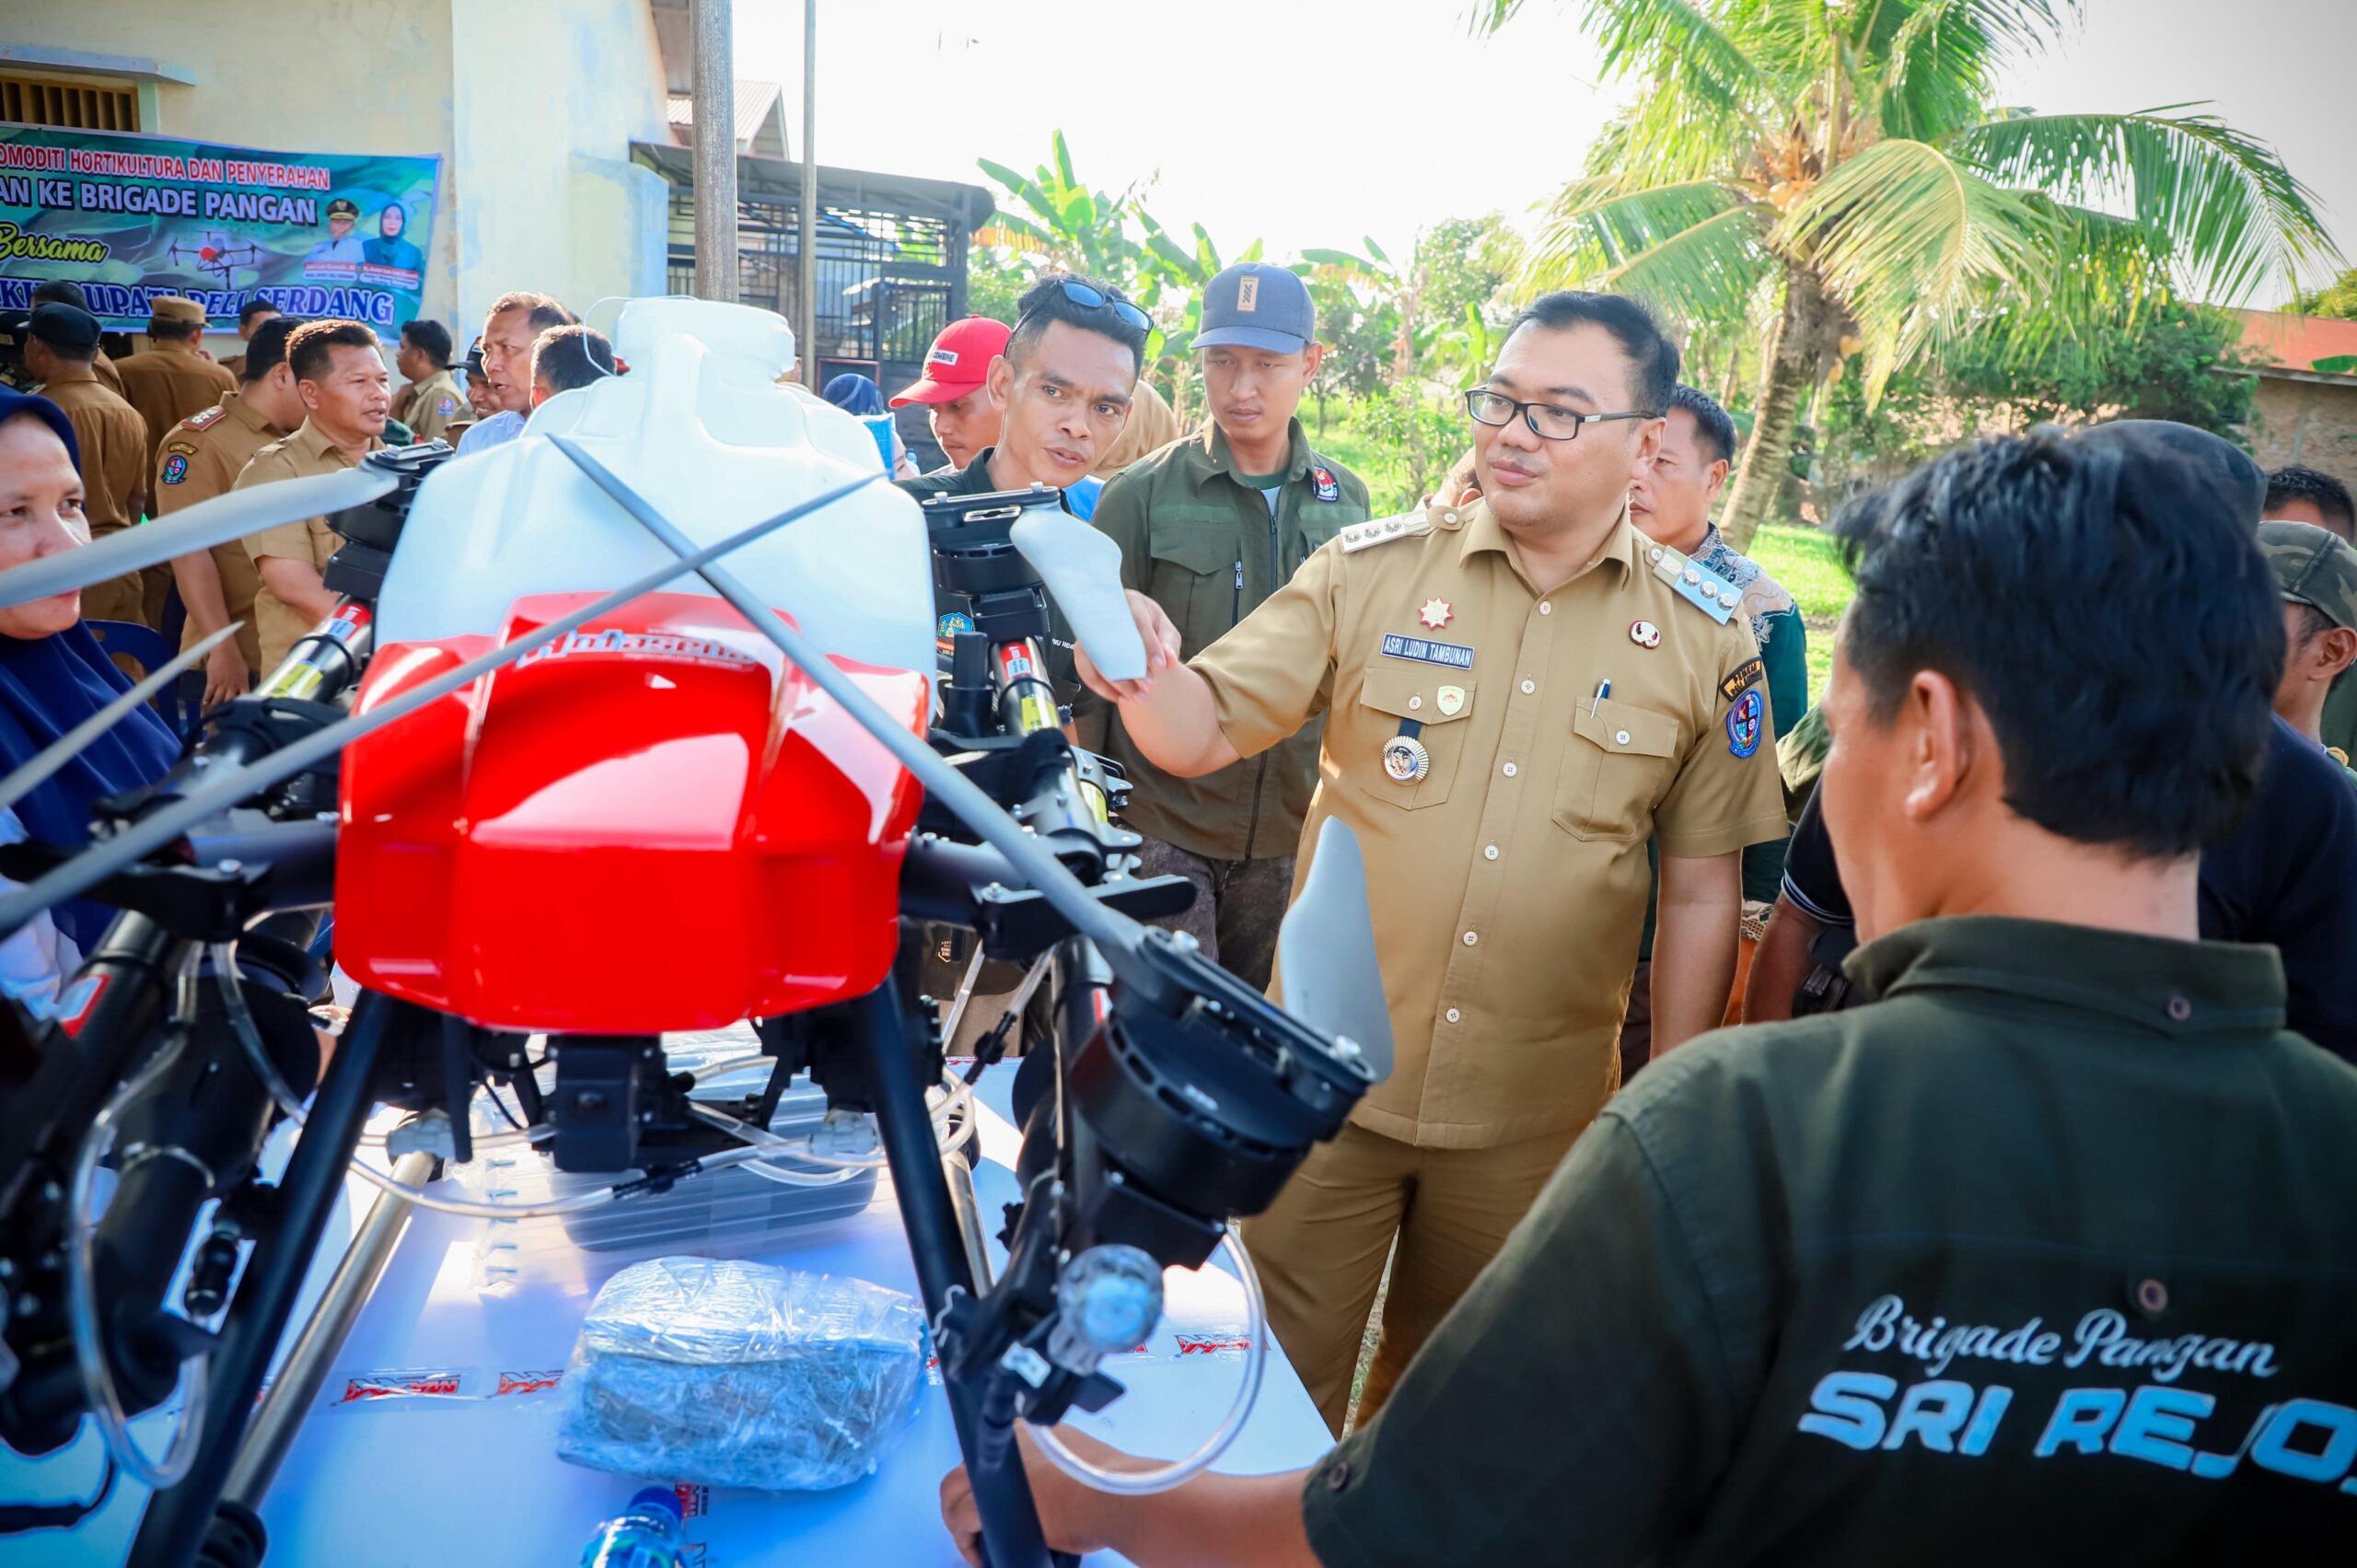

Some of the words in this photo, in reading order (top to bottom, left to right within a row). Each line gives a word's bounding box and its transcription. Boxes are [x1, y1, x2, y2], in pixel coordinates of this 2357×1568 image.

[70, 149, 186, 180] HORTIKULTURA
[188, 158, 223, 182] DAN
[226, 161, 331, 190] PENYERAHAN
[39, 180, 72, 207] KE
[81, 183, 197, 215] BRIGADE
[205, 192, 316, 224] PANGAN
[254, 286, 394, 323] SERDANG
[1384, 636, 1403, 654] ASRI
[1404, 640, 1428, 658] LUDIN
[1429, 644, 1472, 667] TAMBUNAN
[1841, 1294, 2062, 1377] Brigade
[2063, 1307, 2280, 1382] Pangan
[1798, 1371, 2014, 1457] SRI
[2033, 1385, 2357, 1494] REJO
